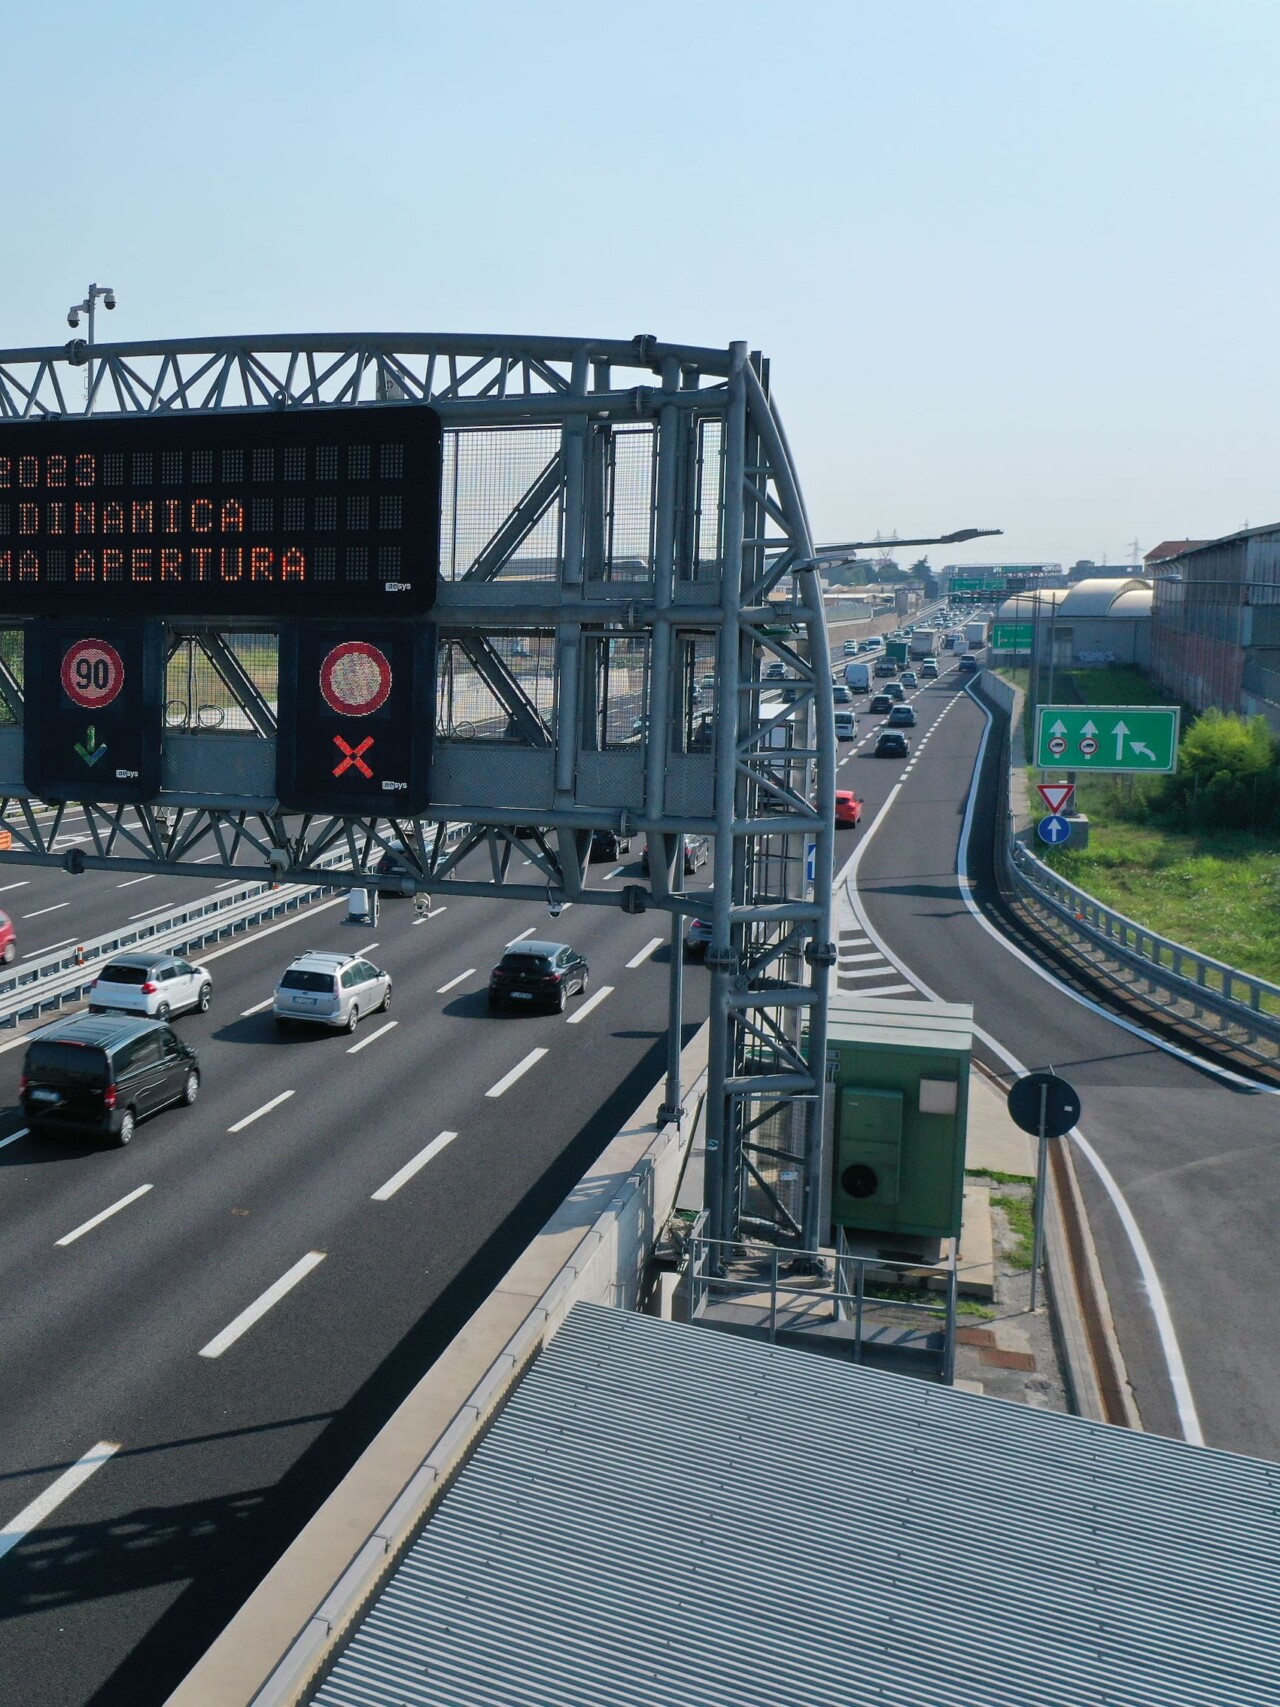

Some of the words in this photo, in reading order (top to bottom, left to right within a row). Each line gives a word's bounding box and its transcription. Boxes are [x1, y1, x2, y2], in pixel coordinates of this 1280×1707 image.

[19, 499, 244, 535] DINAMICA
[75, 547, 306, 582] APERTURA
[75, 657, 110, 690] 90
